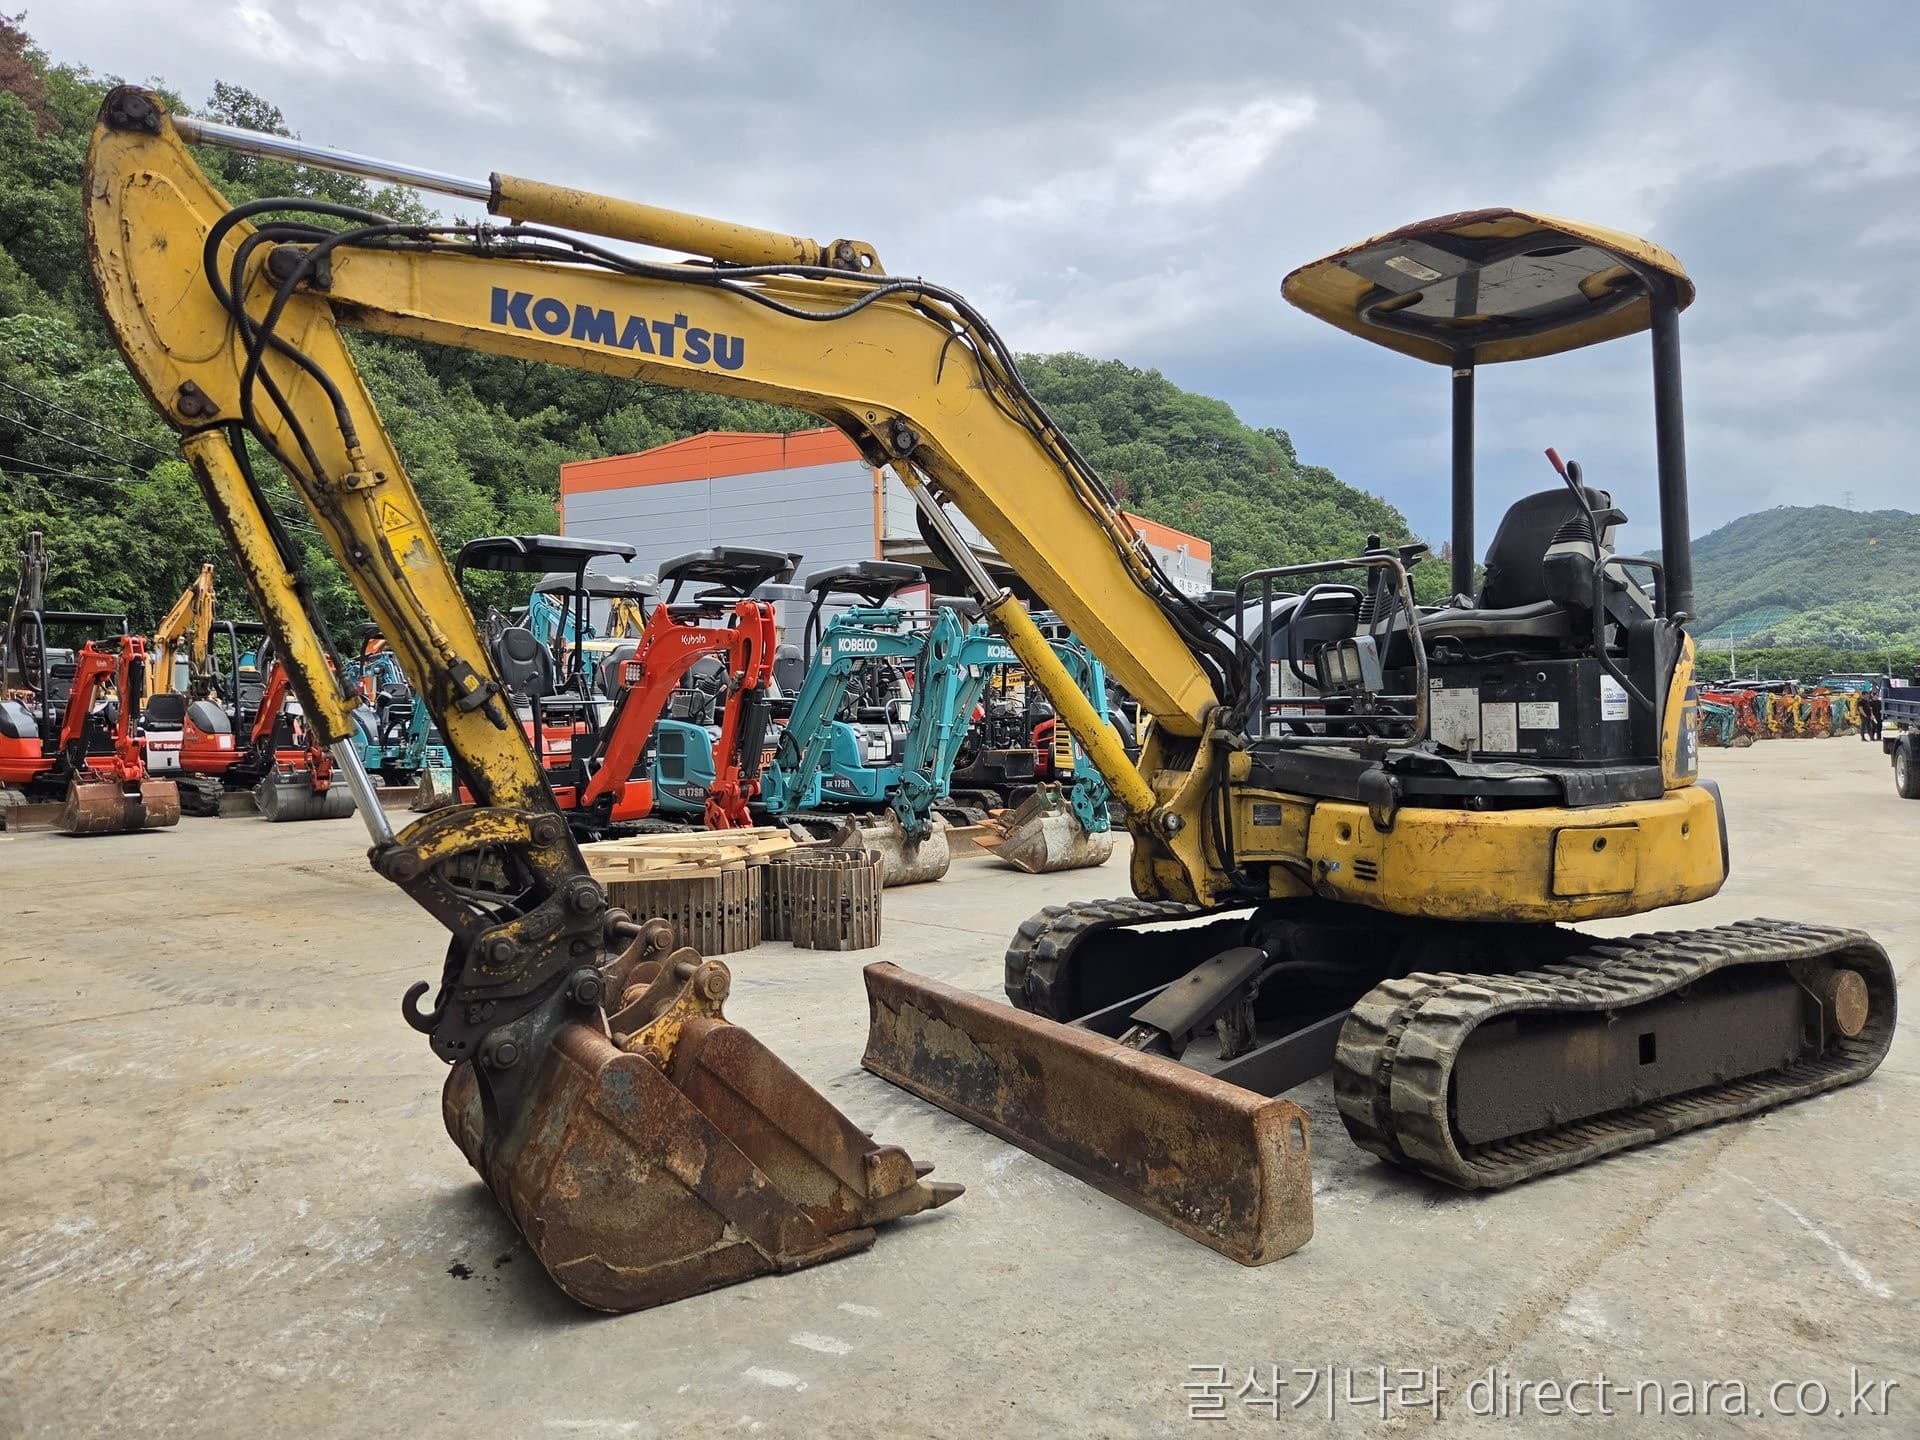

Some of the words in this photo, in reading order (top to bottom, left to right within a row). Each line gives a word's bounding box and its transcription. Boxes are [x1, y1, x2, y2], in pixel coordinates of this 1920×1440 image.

[490, 286, 745, 371] KOMATSU
[681, 633, 706, 646] Kubota
[838, 637, 878, 653] KOBELCO
